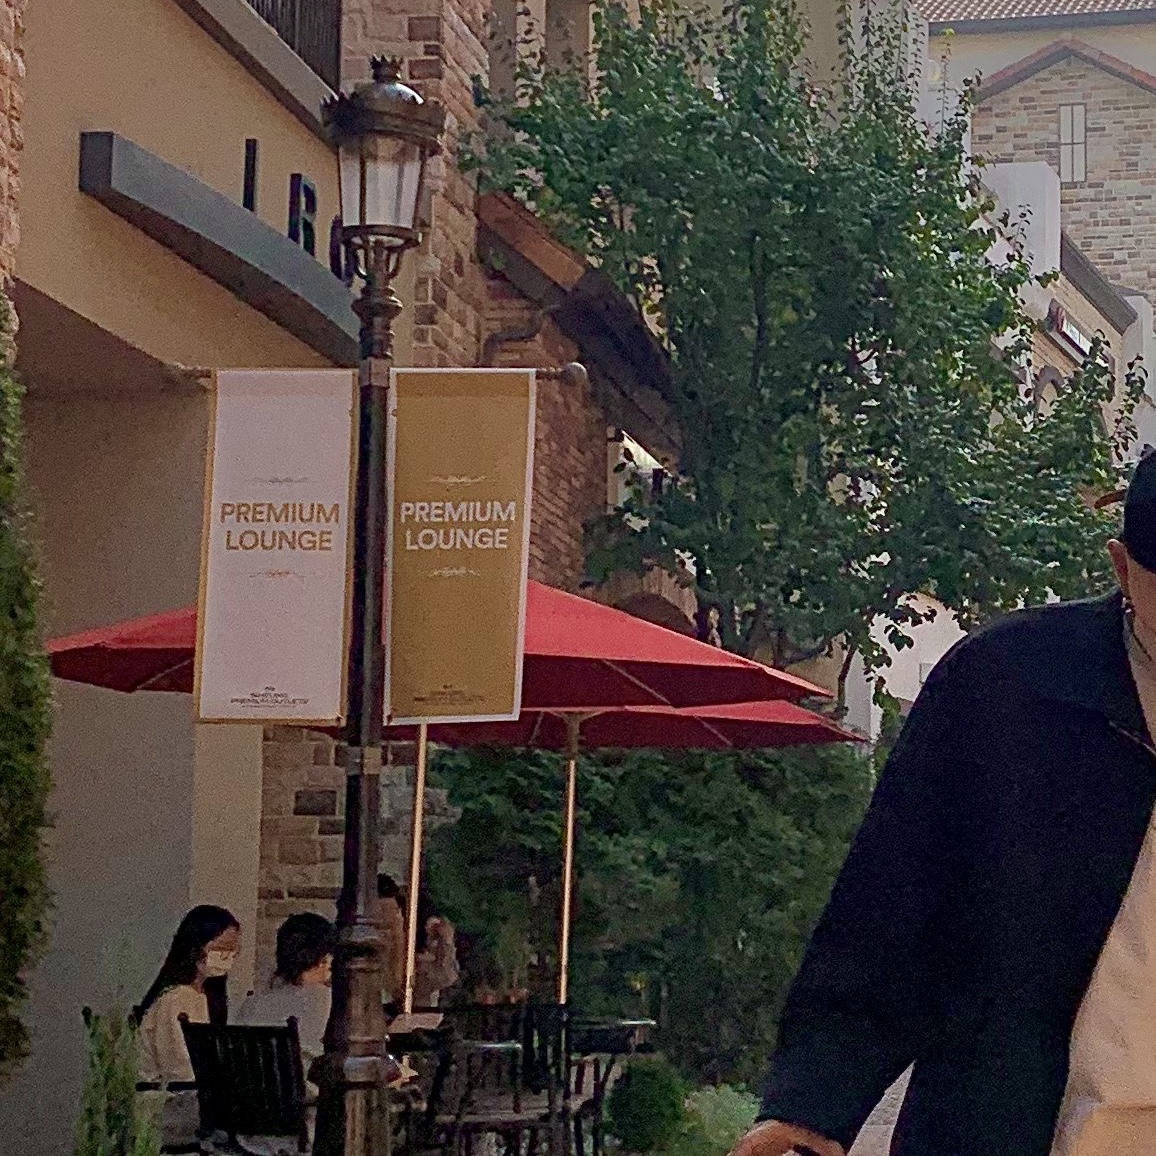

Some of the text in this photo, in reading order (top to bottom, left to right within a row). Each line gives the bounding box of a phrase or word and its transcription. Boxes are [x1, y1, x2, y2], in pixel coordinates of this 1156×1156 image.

[220, 502, 340, 526] PREMIUM
[400, 501, 516, 524] PREMIUM
[225, 530, 333, 551] LOUNGE
[405, 528, 510, 550] LOUNGE
